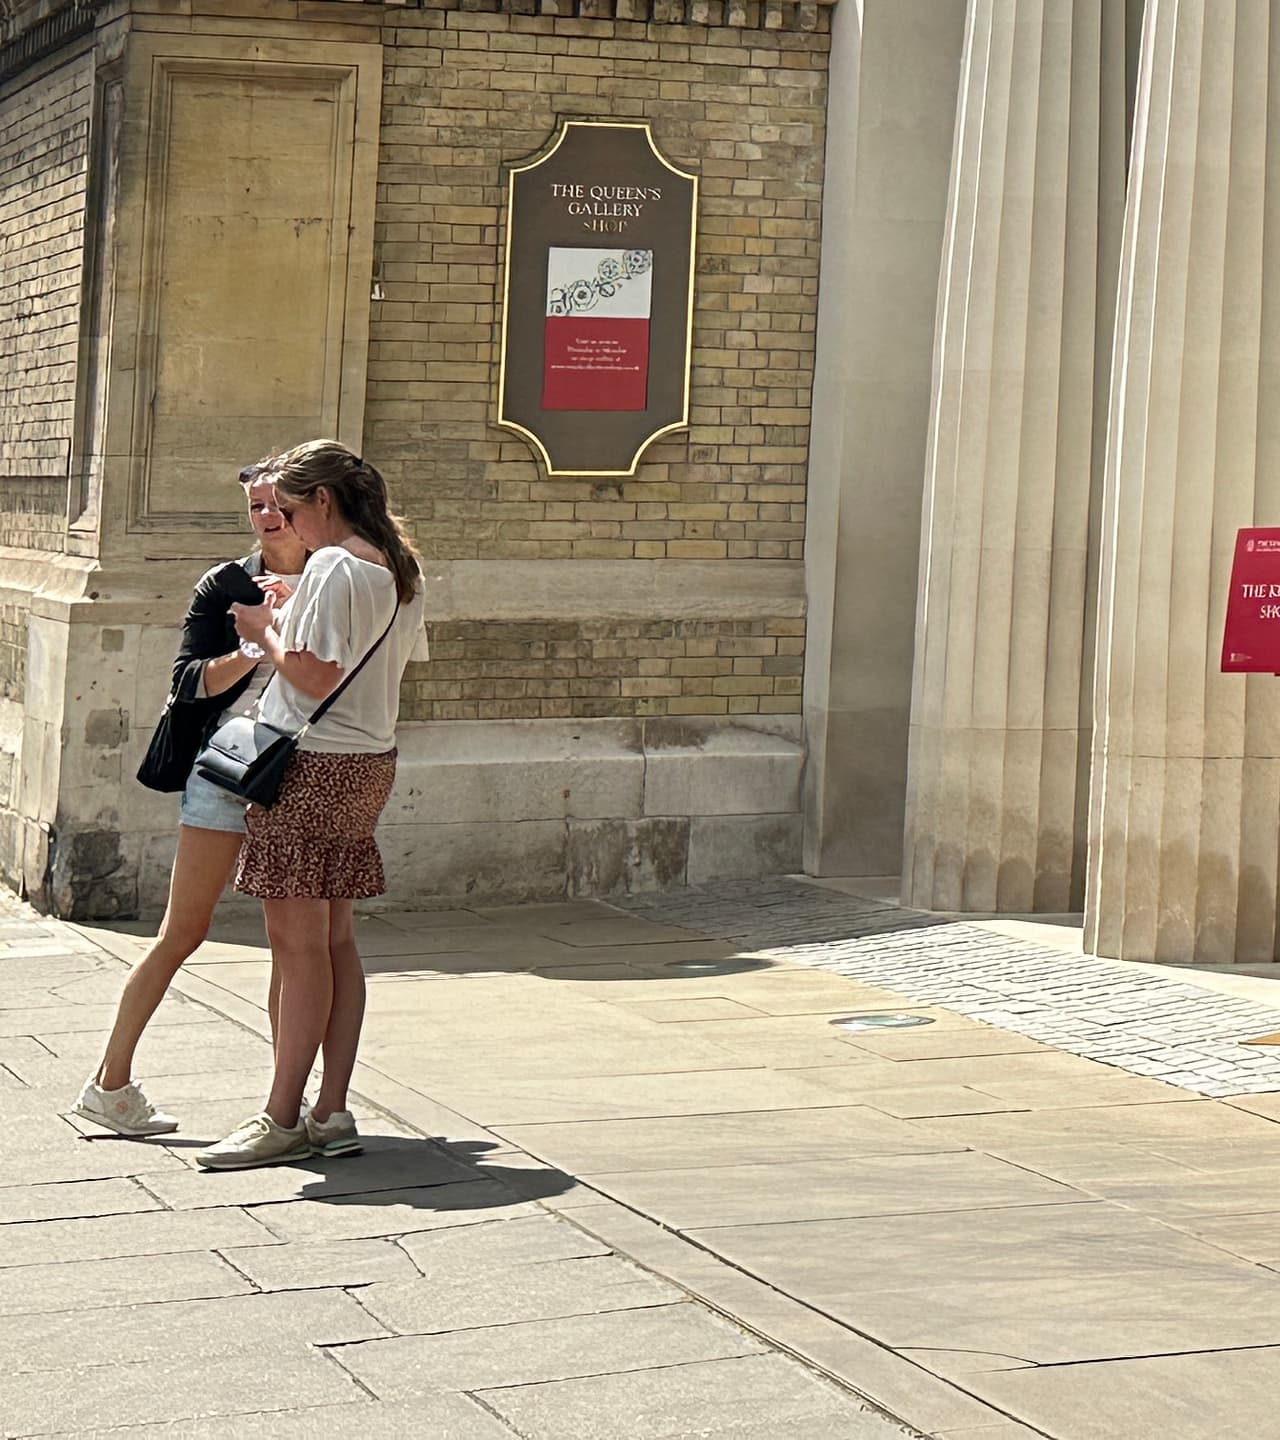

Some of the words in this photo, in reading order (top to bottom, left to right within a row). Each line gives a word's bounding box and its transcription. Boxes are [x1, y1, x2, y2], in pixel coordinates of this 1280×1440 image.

[551, 183, 585, 199] THE
[590, 185, 662, 201] QUEEN'S
[568, 201, 643, 217] GALLERY
[583, 219, 628, 233] SHOP
[1241, 583, 1268, 599] THE
